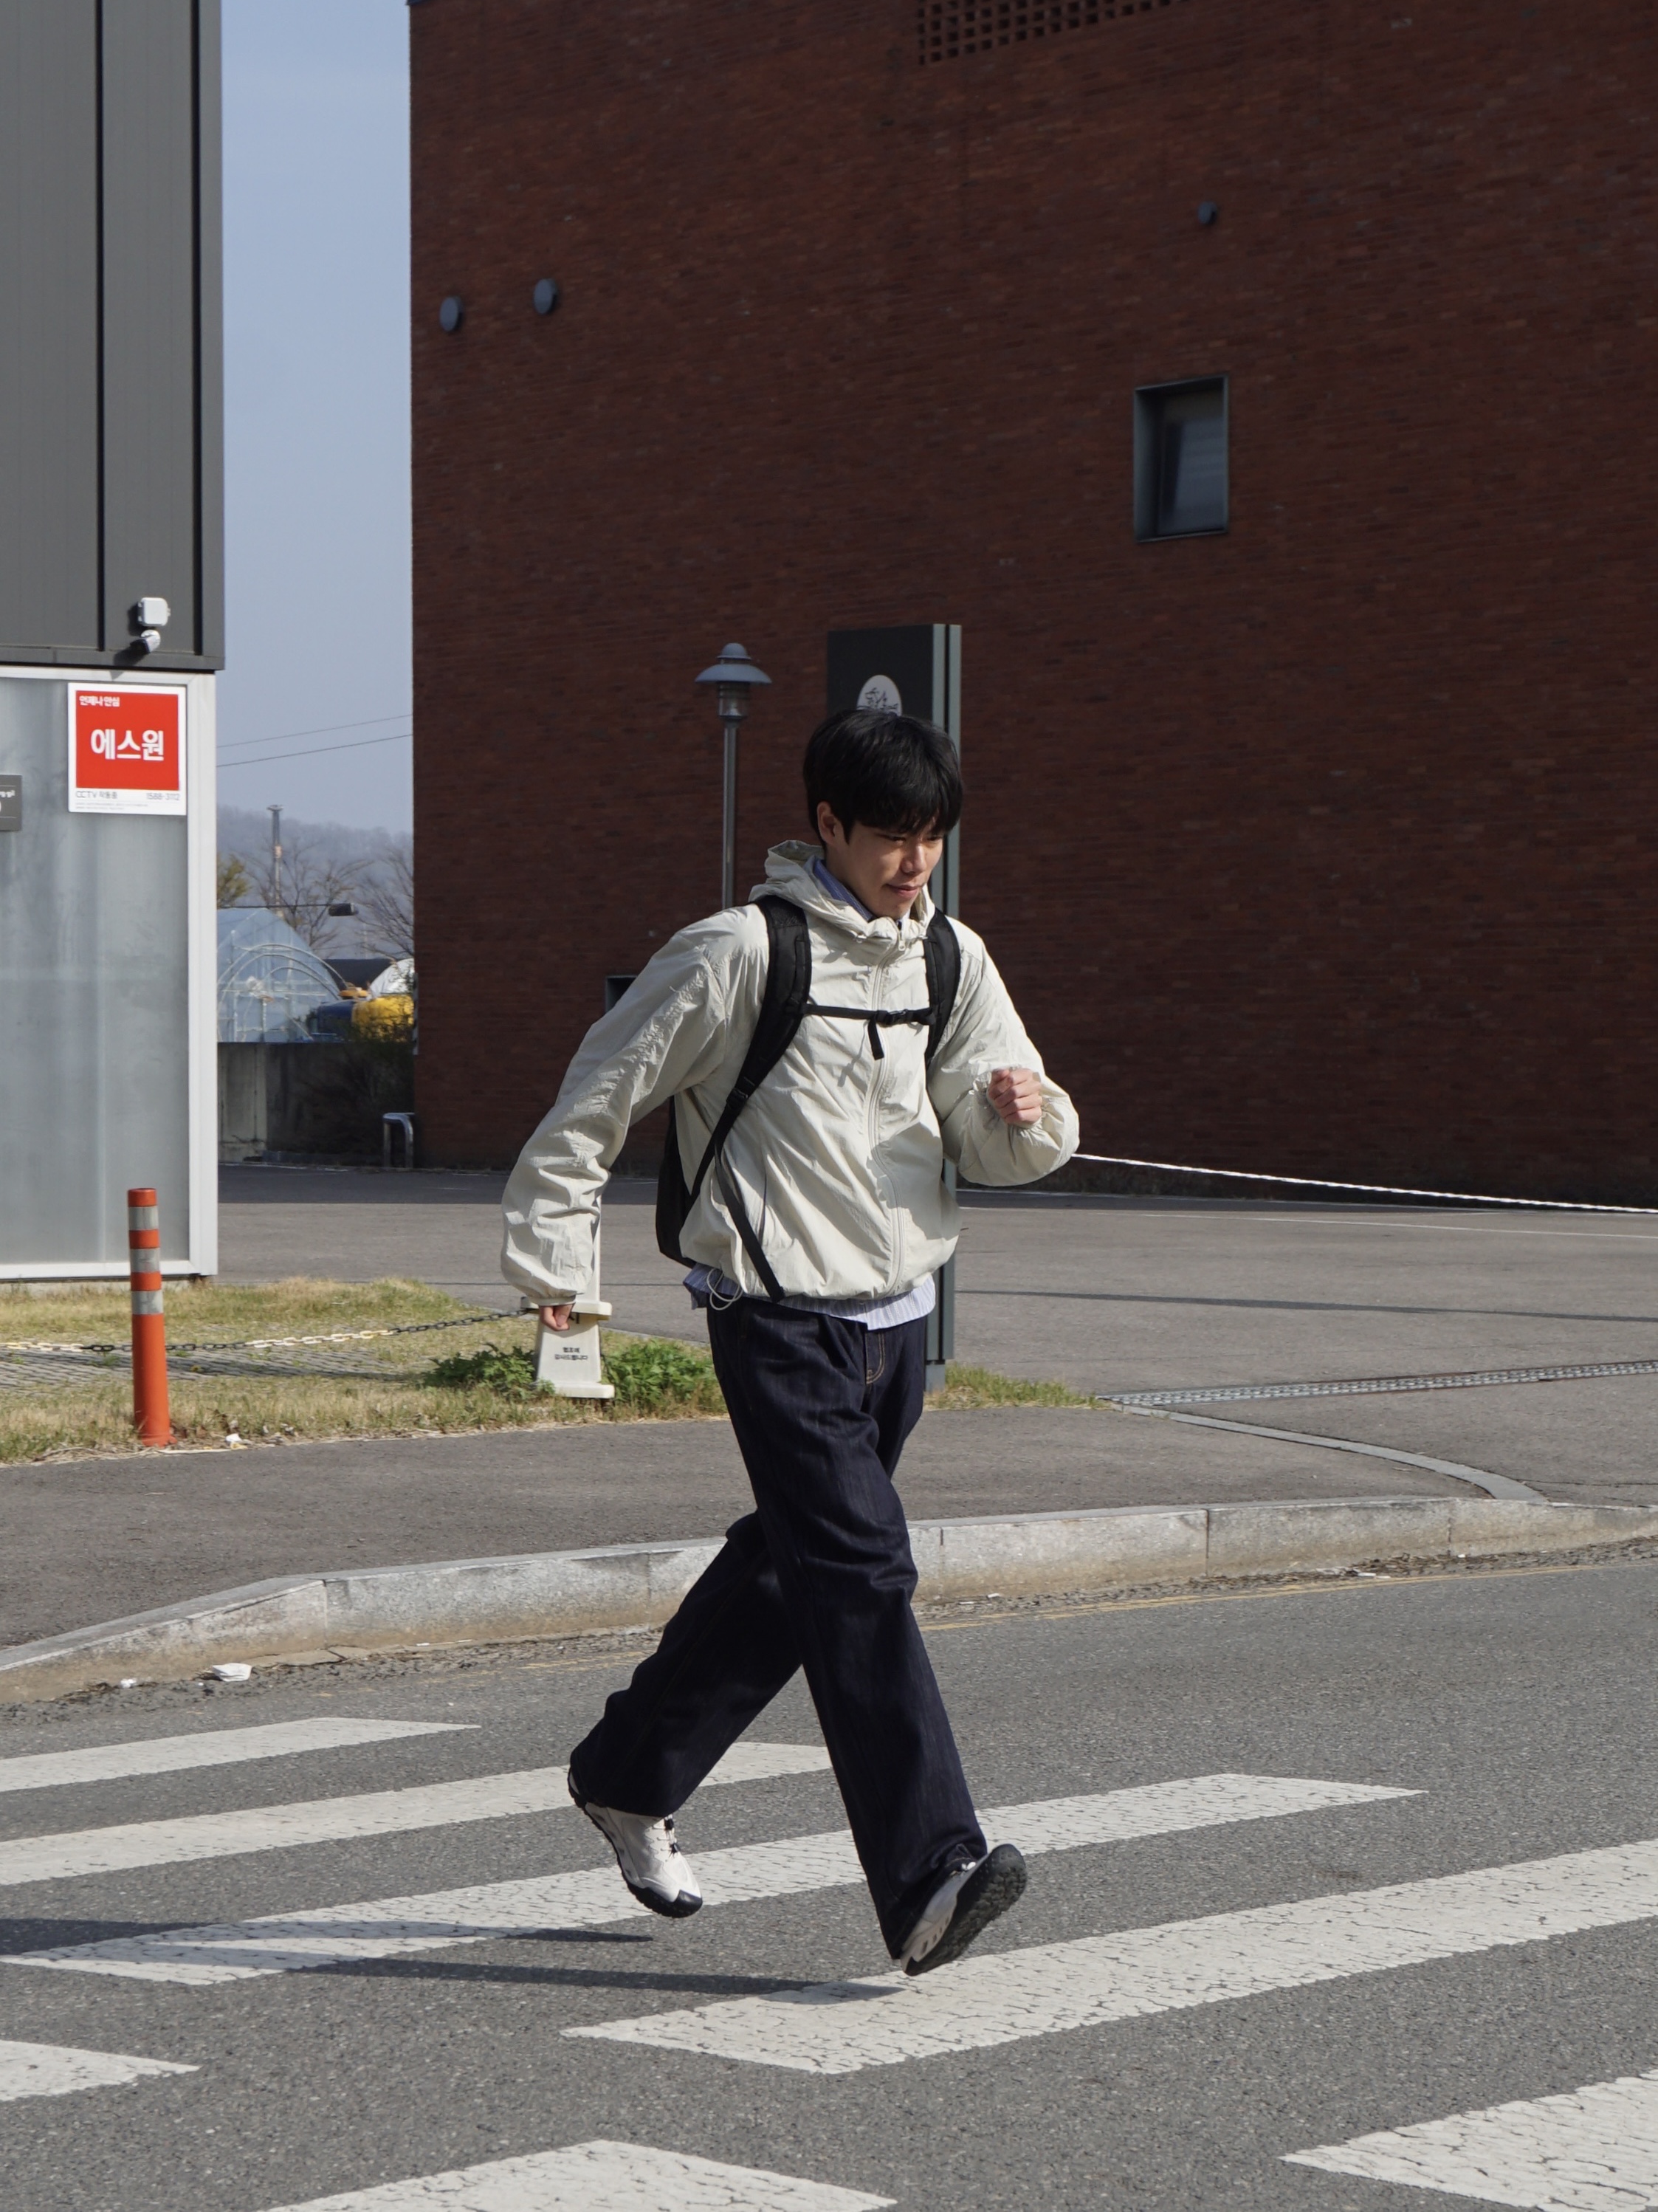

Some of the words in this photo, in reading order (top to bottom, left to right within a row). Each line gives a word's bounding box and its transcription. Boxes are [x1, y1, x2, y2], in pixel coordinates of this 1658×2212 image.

[80, 695, 103, 706] 언제나
[104, 696, 120, 707] 안심
[91, 729, 164, 761] 에스원
[147, 793, 180, 801] 1588-3112
